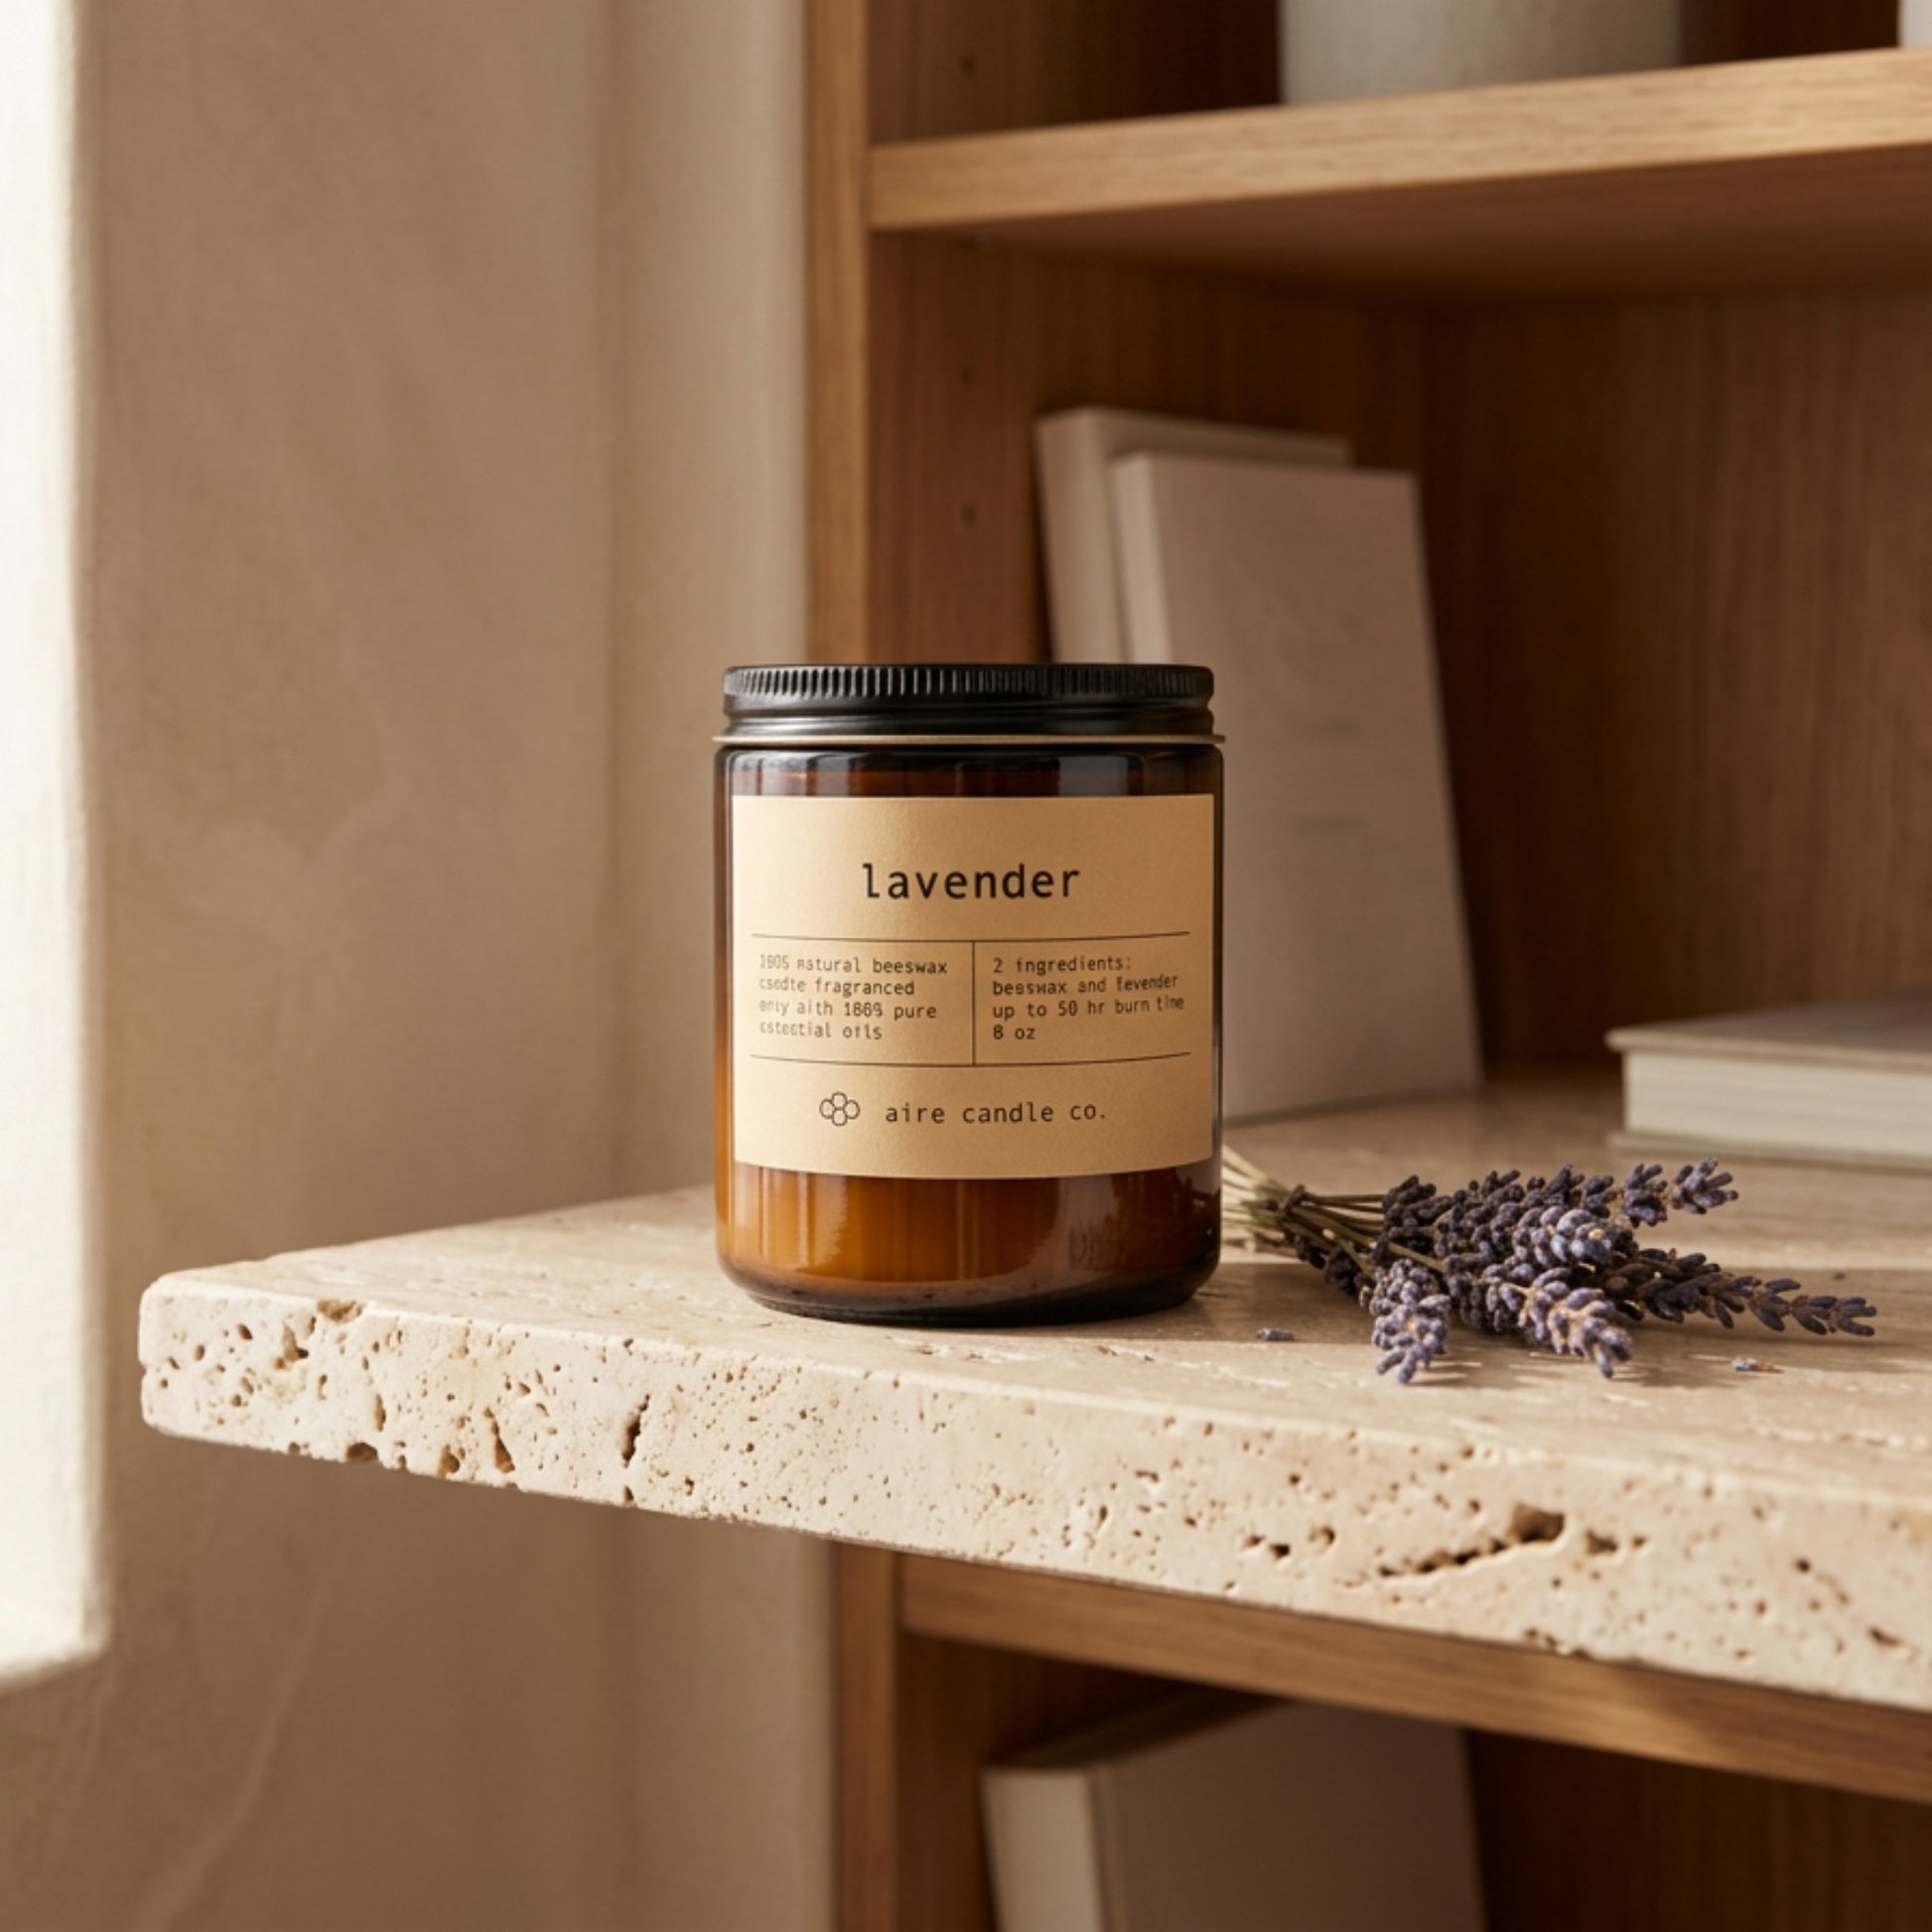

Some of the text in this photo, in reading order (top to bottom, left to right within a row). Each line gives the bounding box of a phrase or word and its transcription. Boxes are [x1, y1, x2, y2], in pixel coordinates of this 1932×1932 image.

[862, 862, 1080, 899] lavender
[873, 958, 947, 974] beeswax
[994, 958, 1003, 973] 2
[816, 978, 914, 997] fragranced
[1078, 980, 1106, 993] and
[895, 1006, 936, 1020] pure
[993, 1006, 1014, 1021] up
[1028, 1004, 1046, 1018] to
[1058, 1001, 1077, 1016] 50
[1088, 1001, 1105, 1015] hr
[1115, 999, 1149, 1014] burn
[994, 1025, 1035, 1039] 8 oz
[886, 1102, 1105, 1124] aire candle co.
